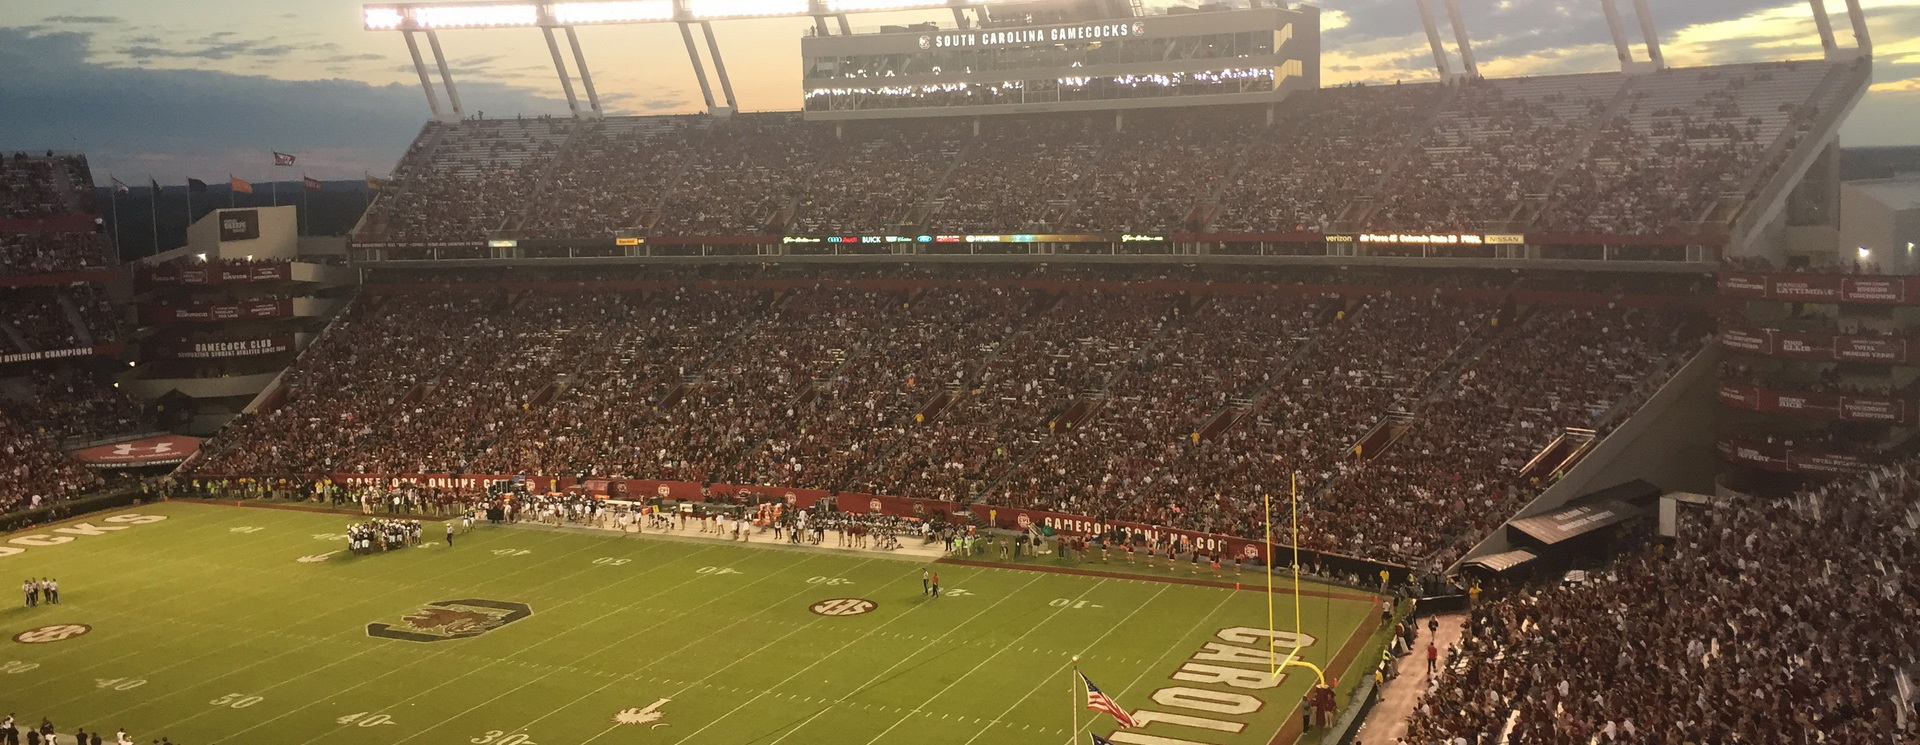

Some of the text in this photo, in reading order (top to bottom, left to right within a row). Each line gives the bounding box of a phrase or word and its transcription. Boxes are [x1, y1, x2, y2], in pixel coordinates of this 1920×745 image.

[936, 23, 1128, 47] SOUTH CAROLINA GAMECOCKS
[195, 339, 272, 352] GAMECOCK CLUB
[4, 347, 93, 363] DIVISION CHAMPIONS
[814, 598, 873, 616] SEC
[1048, 598, 1090, 609] 10
[209, 693, 264, 709] 50
[336, 711, 391, 728] 40
[471, 730, 530, 745] 30
